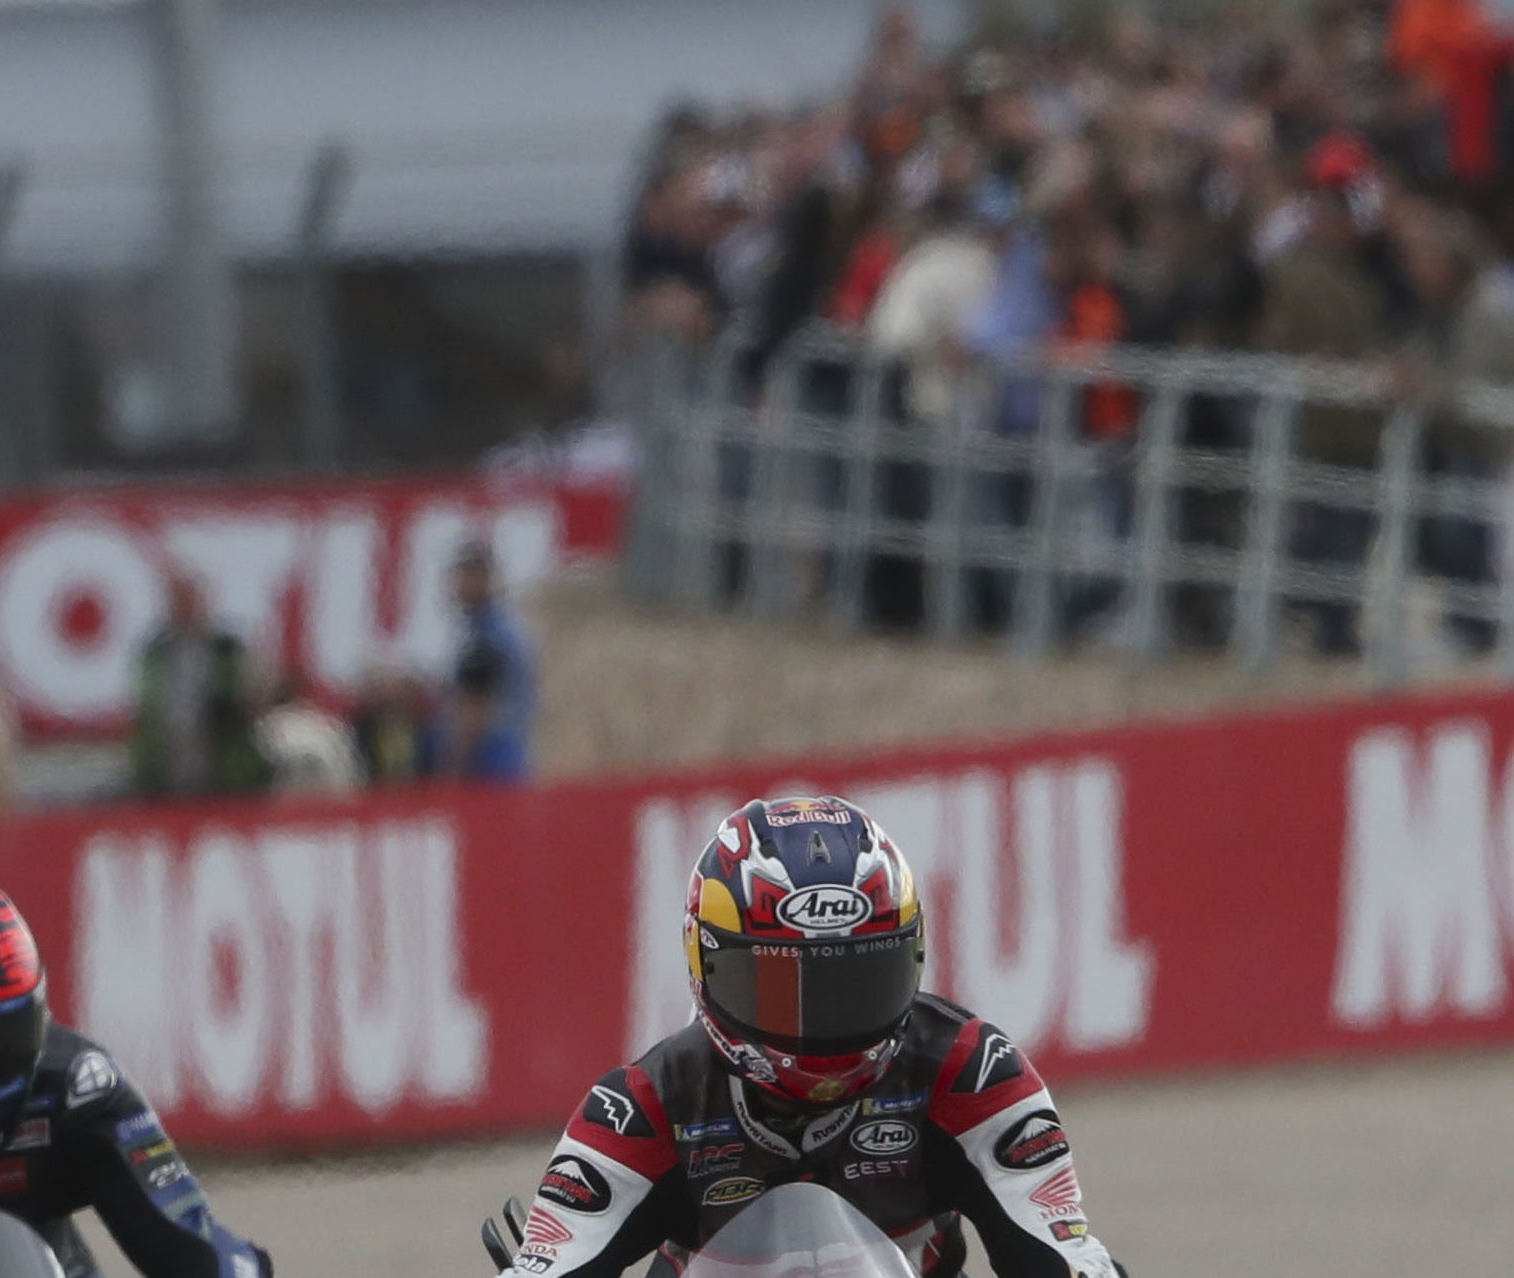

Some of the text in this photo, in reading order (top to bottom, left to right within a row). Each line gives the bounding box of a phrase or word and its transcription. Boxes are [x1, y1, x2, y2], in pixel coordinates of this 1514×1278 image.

[793, 893, 859, 917] Arai
[751, 936, 901, 958] GIVES YOU WINGS
[75, 815, 487, 1112] MOTUL
[523, 1244, 558, 1257] NDA
